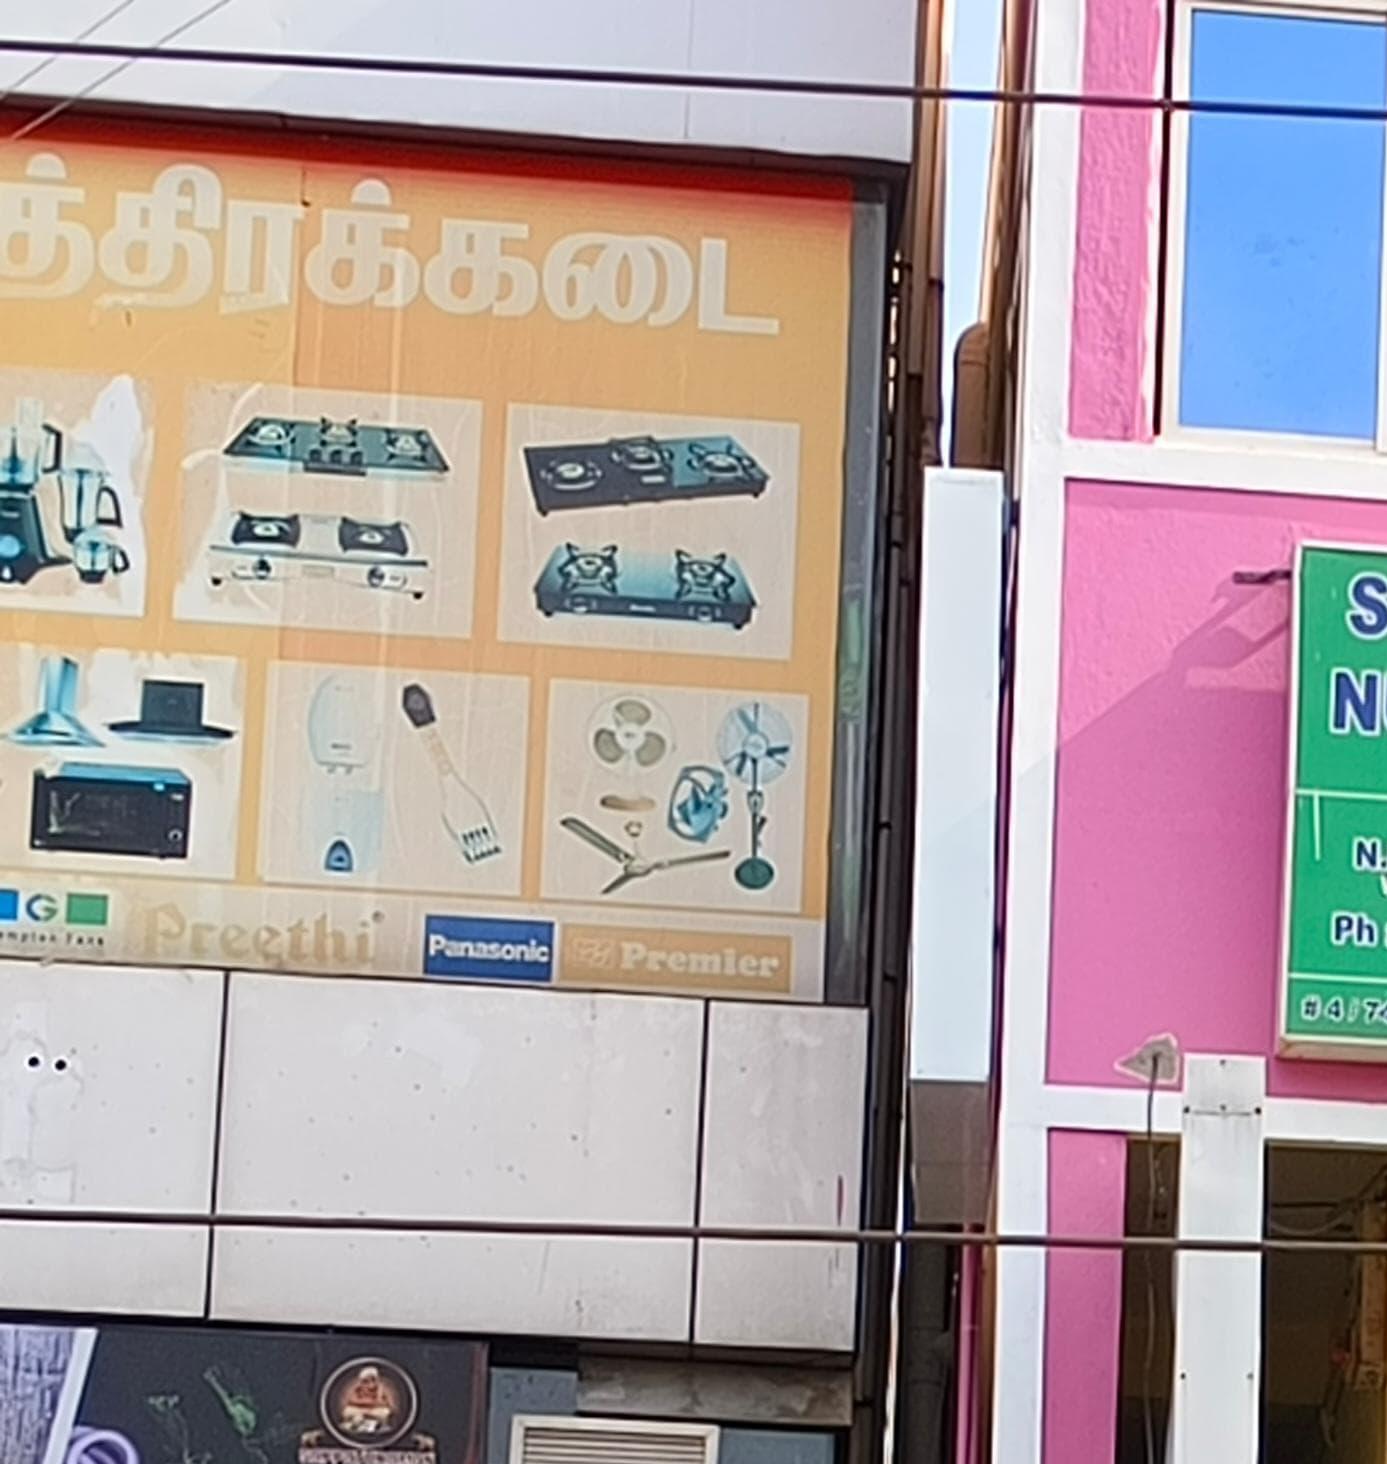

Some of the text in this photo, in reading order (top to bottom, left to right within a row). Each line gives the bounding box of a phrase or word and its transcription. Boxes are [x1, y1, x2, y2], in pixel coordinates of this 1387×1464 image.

[135, 903, 374, 966] Preethi
[1332, 912, 1375, 946] Ph
[428, 934, 551, 963] Panasonic
[620, 942, 780, 978] Premier
